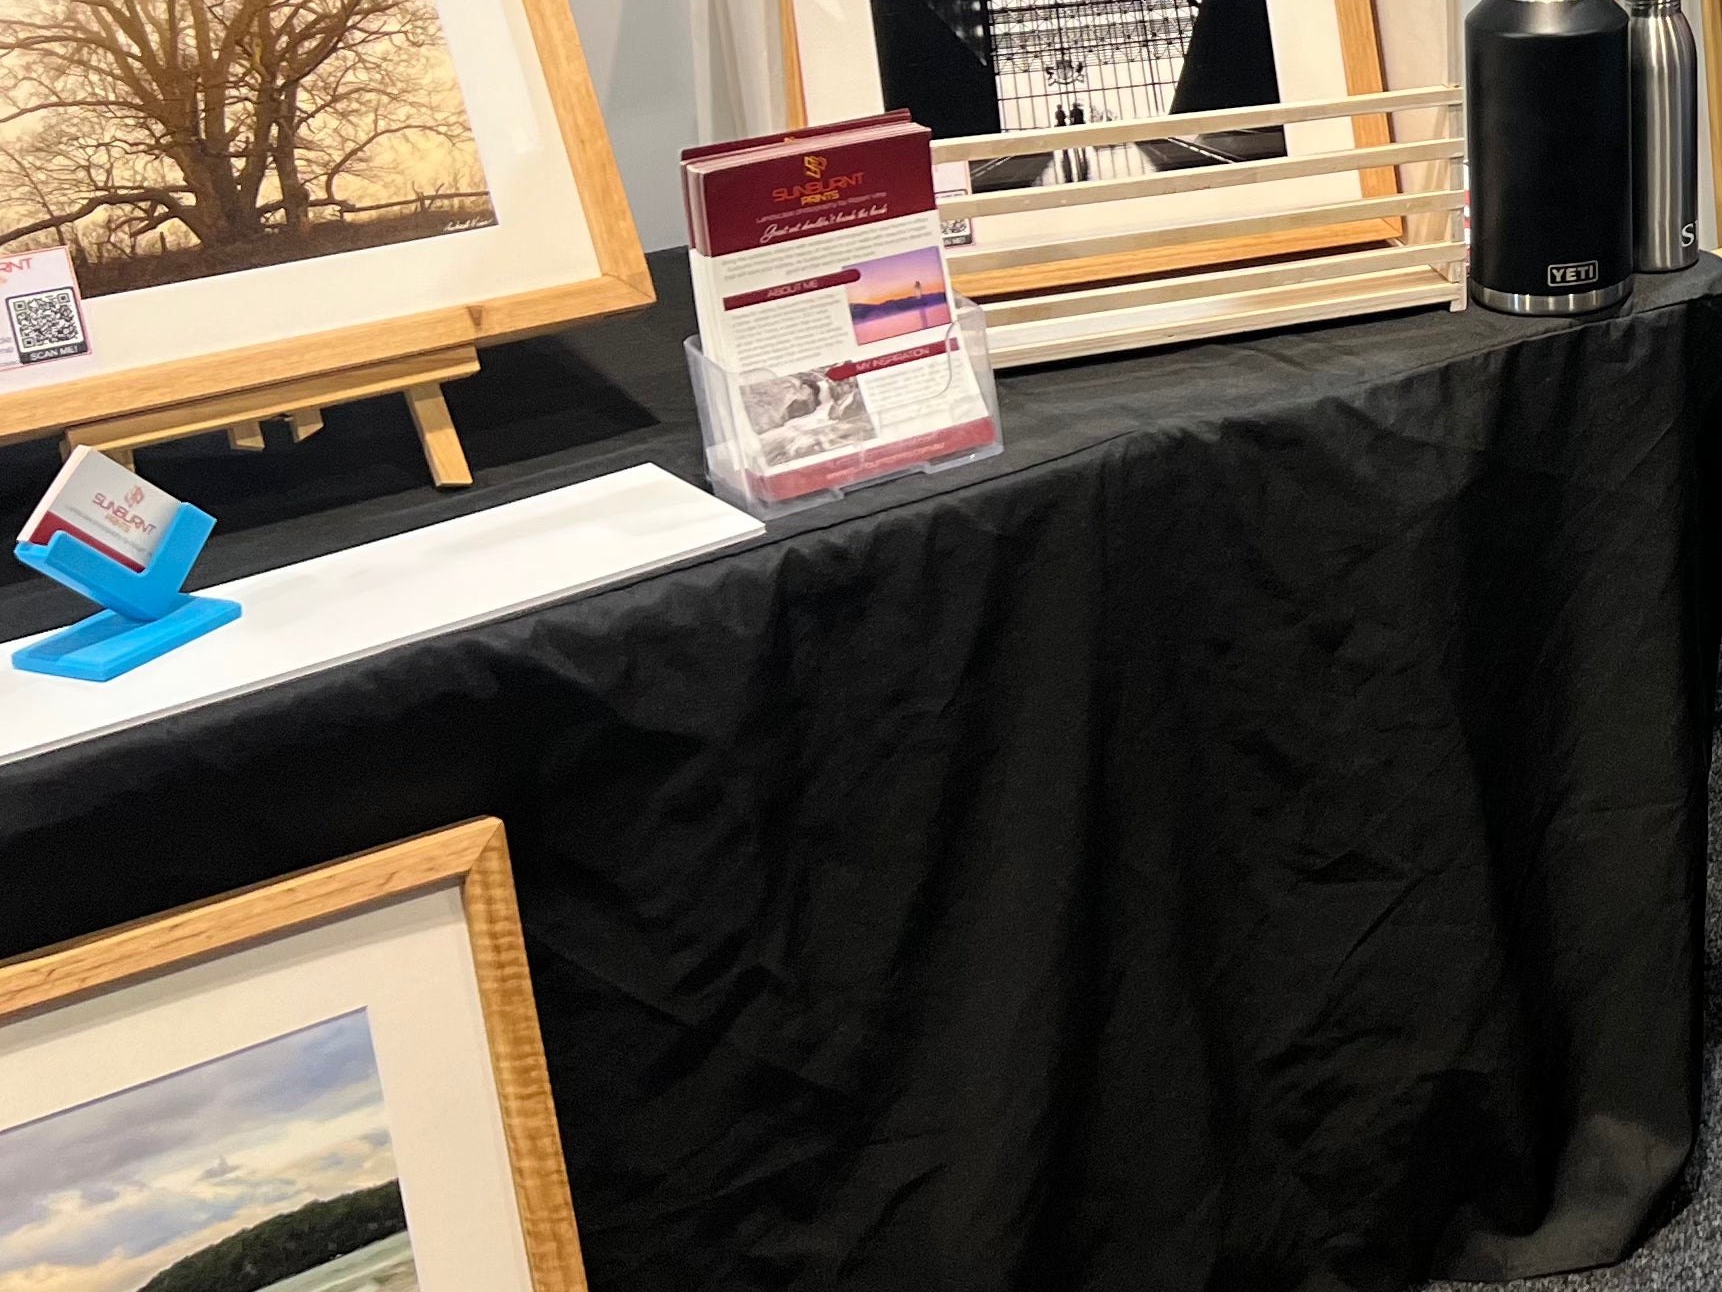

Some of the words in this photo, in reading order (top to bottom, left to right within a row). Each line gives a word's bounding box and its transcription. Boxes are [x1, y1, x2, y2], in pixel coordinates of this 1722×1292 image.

[772, 172, 865, 202] SUNBURNT
[801, 190, 840, 205] PRINTS
[1551, 264, 1594, 283] YETI
[767, 282, 802, 299] ABOUT
[803, 279, 819, 291] ME
[30, 348, 59, 361] SCAN
[60, 345, 79, 356] ME!
[856, 362, 871, 373] MY
[872, 347, 930, 370] INSPIRATION
[92, 493, 157, 535] SUNBURNT
